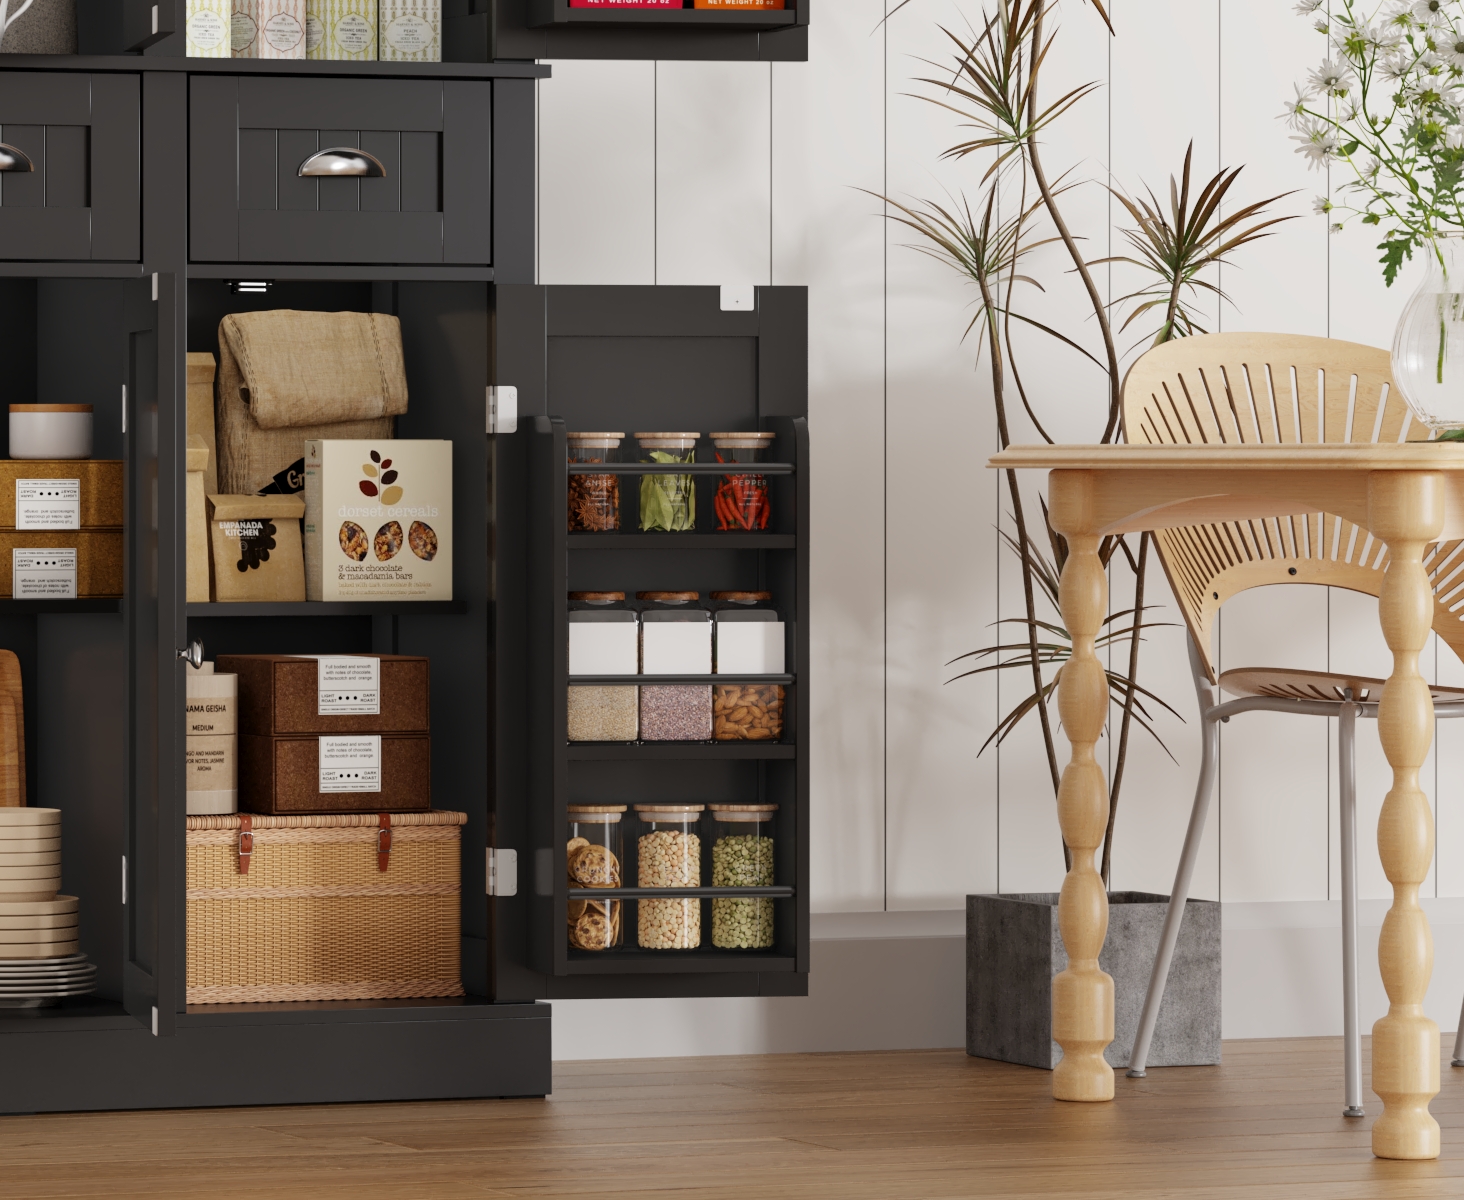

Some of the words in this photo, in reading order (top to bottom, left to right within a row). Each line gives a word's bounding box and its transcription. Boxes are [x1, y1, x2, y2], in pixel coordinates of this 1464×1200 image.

[585, 479, 612, 487] ANISE
[732, 479, 767, 487] PEPPER
[338, 505, 384, 518] dorset
[388, 505, 439, 518] cereals
[219, 521, 263, 529] EMPANADA
[345, 564, 364, 572] dark
[366, 564, 403, 572] chocolate
[395, 572, 413, 580] bars
